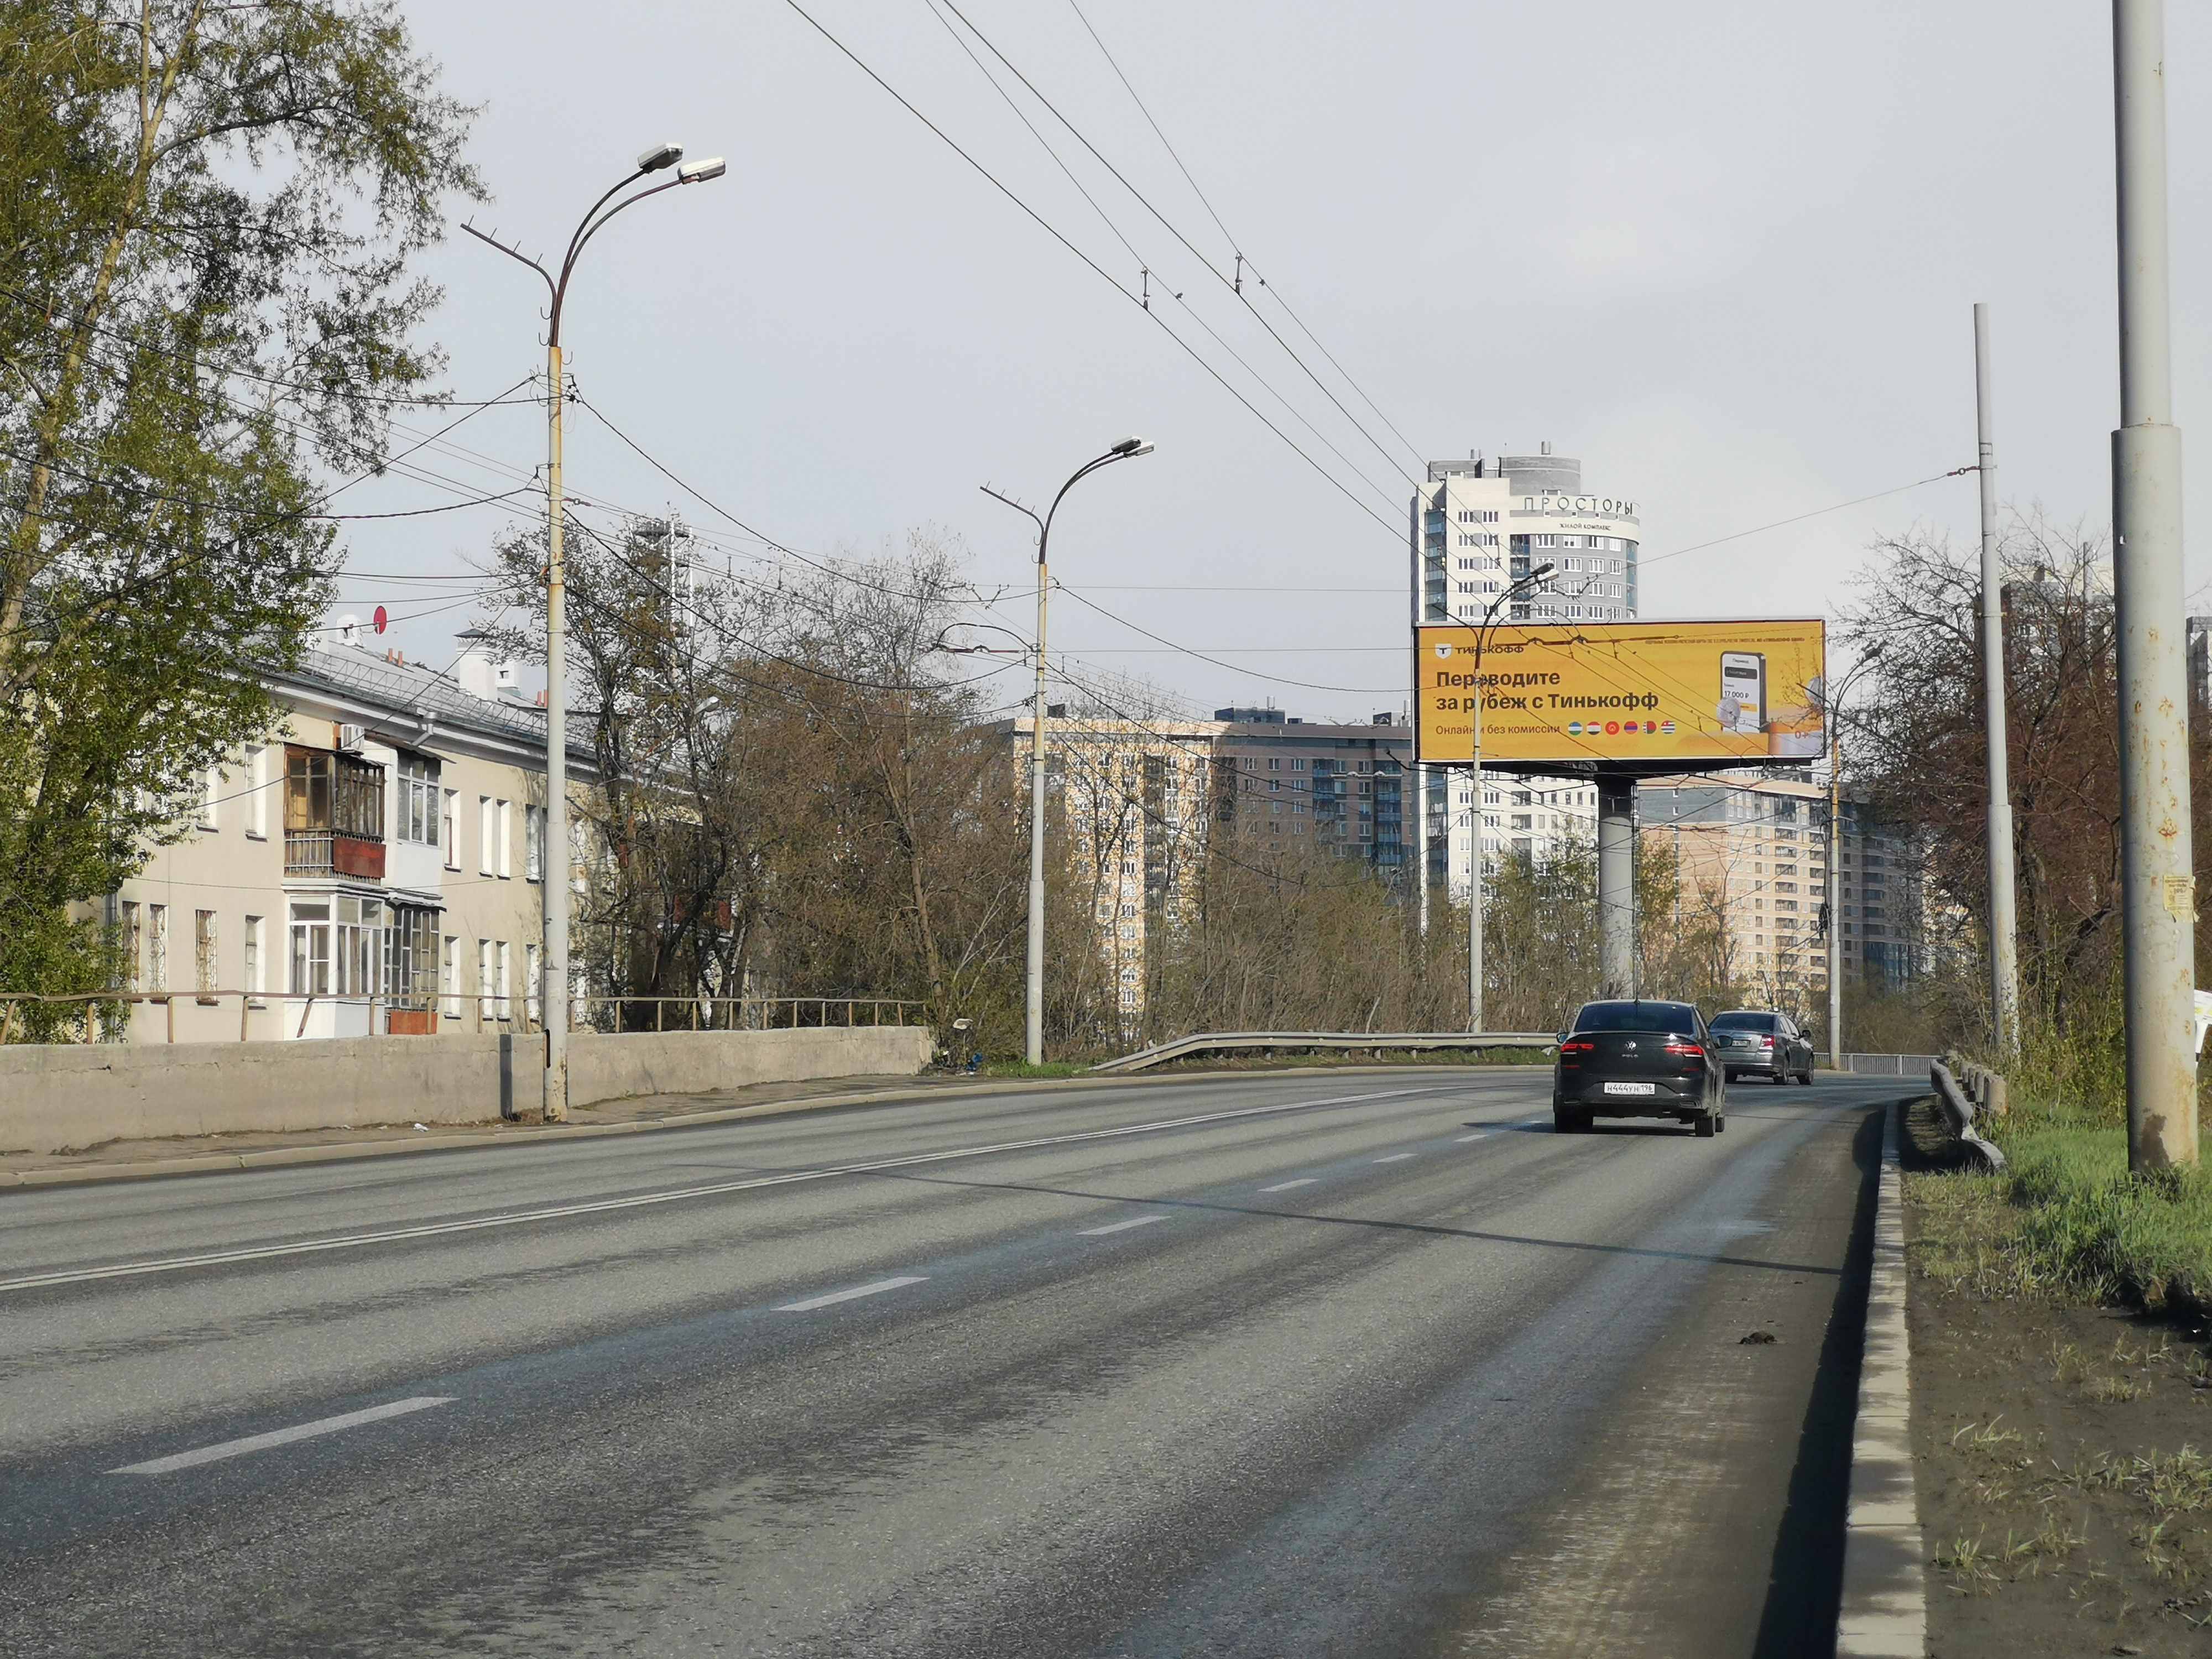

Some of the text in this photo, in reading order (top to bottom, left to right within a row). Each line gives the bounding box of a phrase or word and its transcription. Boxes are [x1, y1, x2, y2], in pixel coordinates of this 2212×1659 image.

[1524, 497, 1632, 515] ПРОСТОРЫ
[1436, 698, 1458, 710] за
[1532, 696, 1543, 708] с
[1547, 692, 1659, 711] Тинькофф
[1487, 724, 1505, 734] без
[1508, 725, 1561, 734] комиссии
